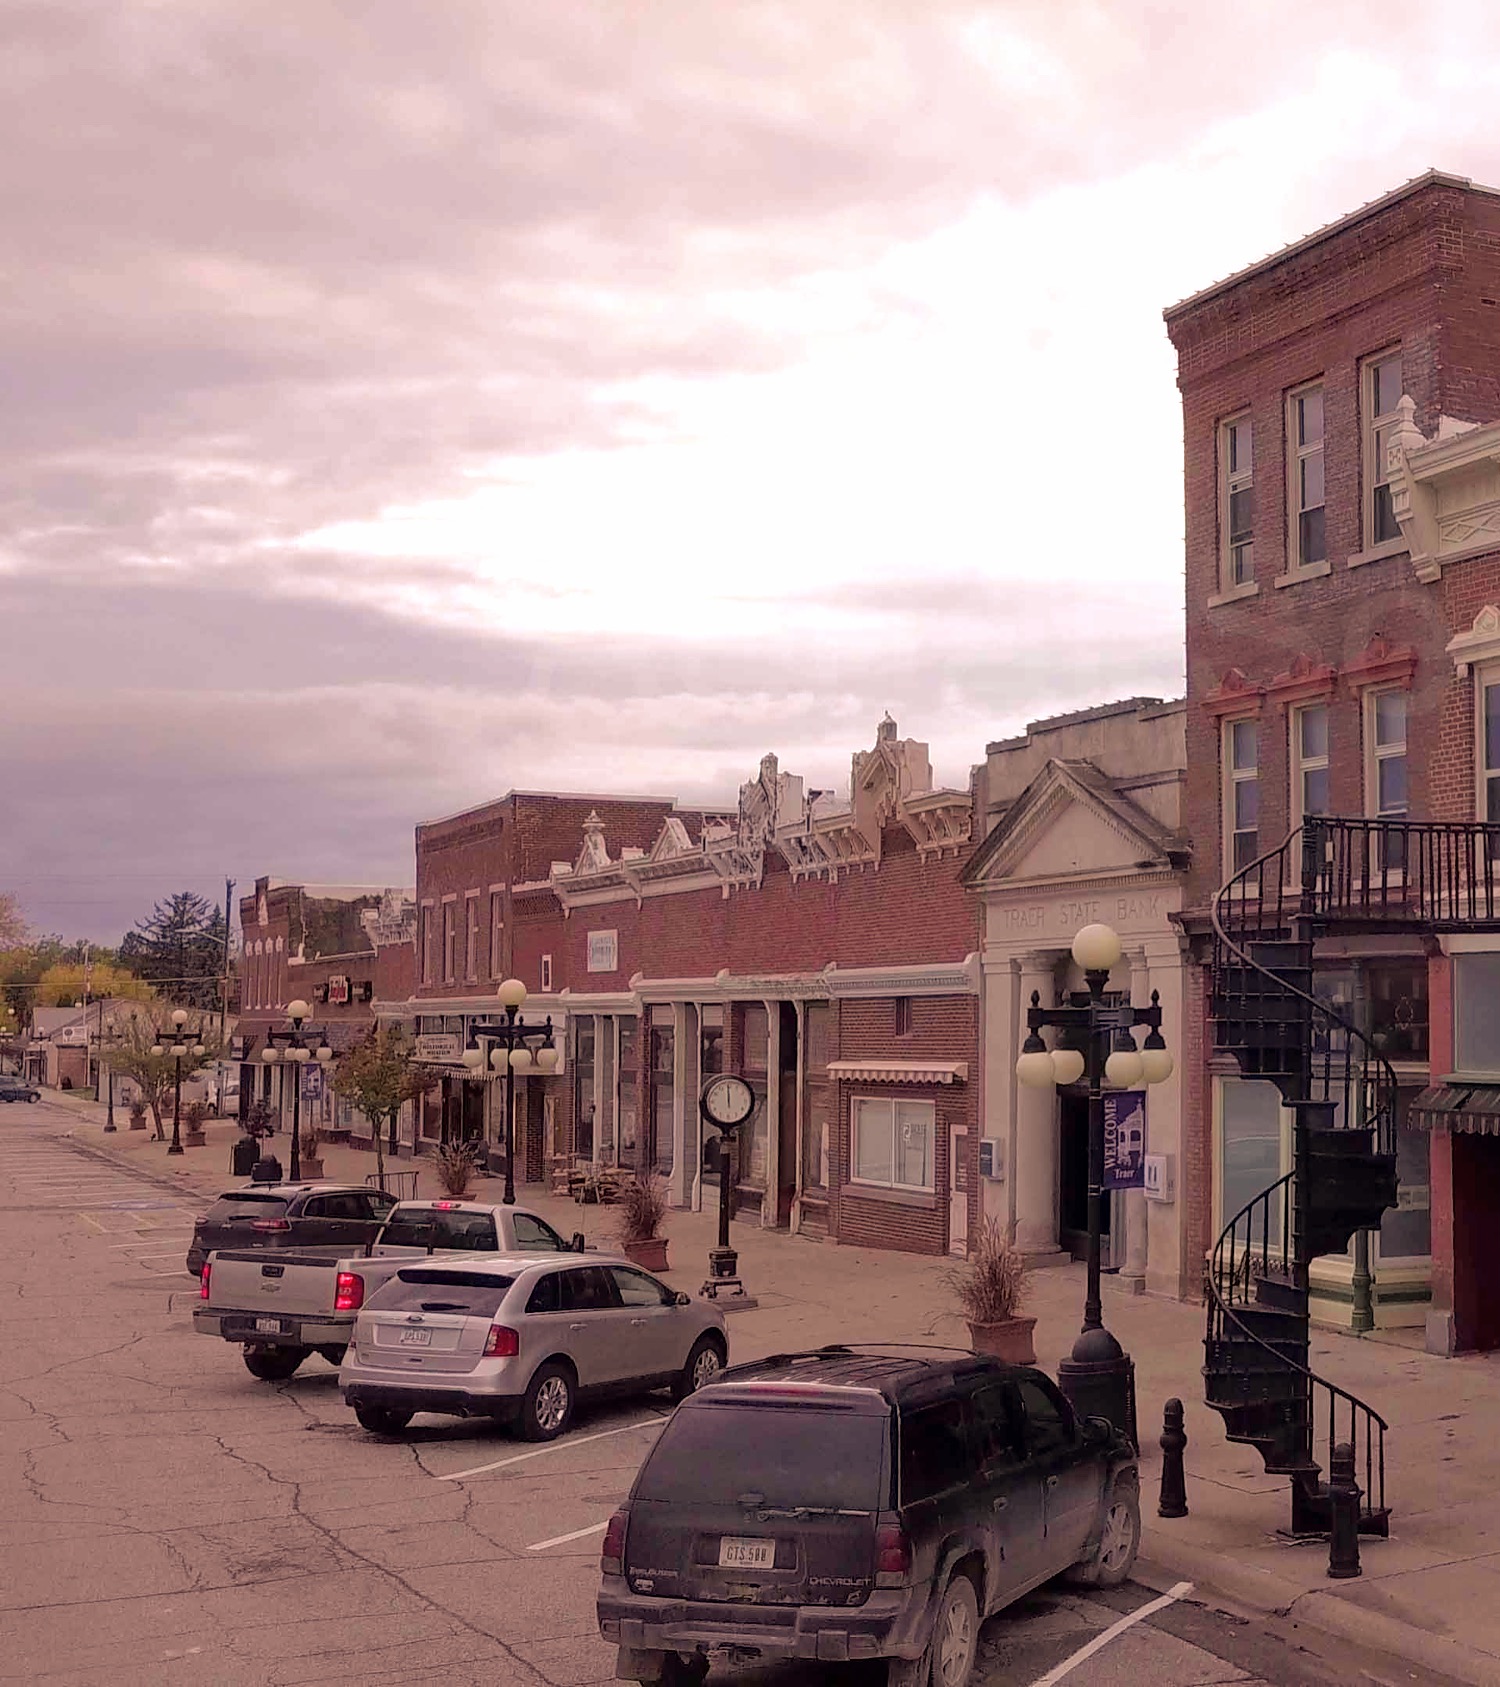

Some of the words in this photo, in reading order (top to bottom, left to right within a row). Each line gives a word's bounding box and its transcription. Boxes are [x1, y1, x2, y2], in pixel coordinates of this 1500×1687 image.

[1060, 900, 1101, 924] STATE
[1116, 895, 1159, 920] BANK
[1104, 1099, 1117, 1169] WELCOME
